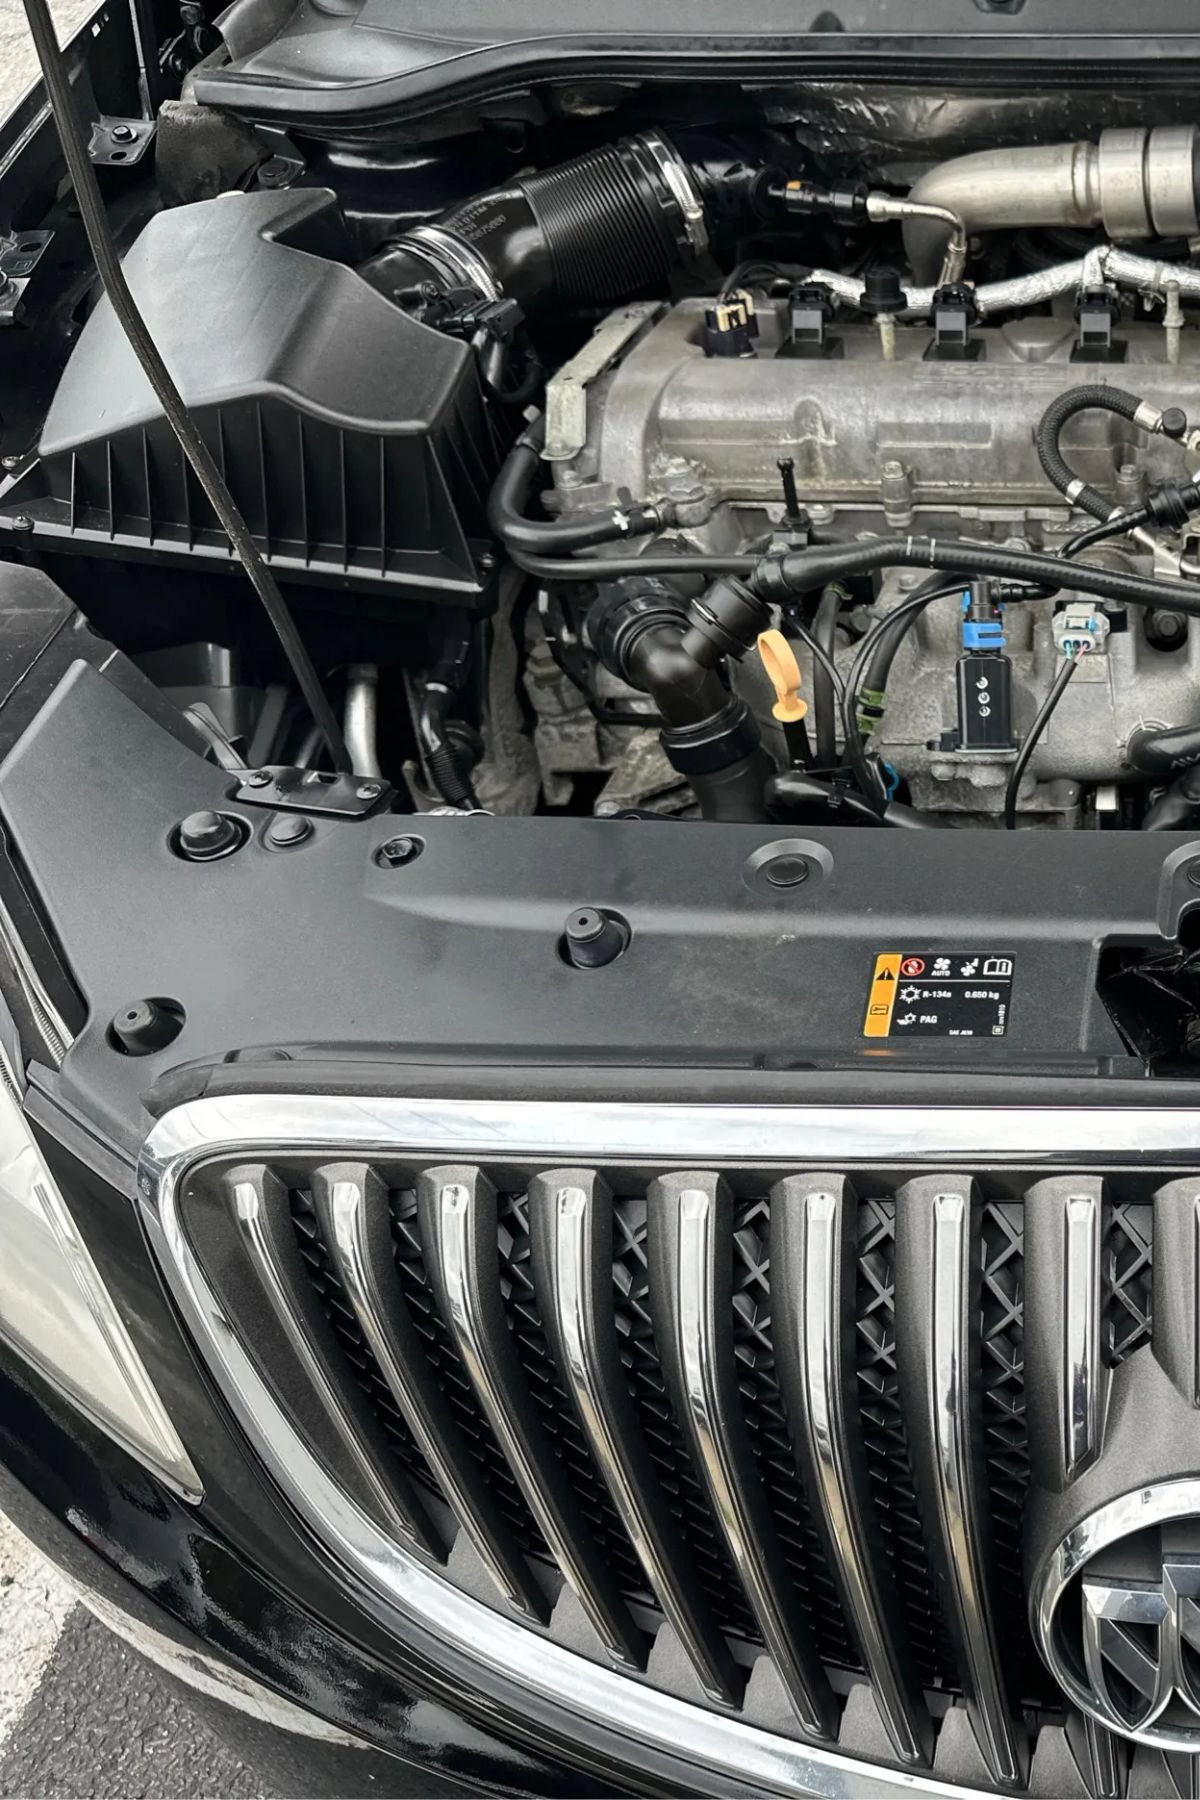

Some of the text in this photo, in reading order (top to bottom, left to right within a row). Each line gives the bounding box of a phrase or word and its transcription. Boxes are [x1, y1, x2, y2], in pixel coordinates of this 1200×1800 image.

[922, 990, 952, 998] R-134a
[988, 991, 1000, 1000] kg
[920, 1015, 938, 1024] PAG
